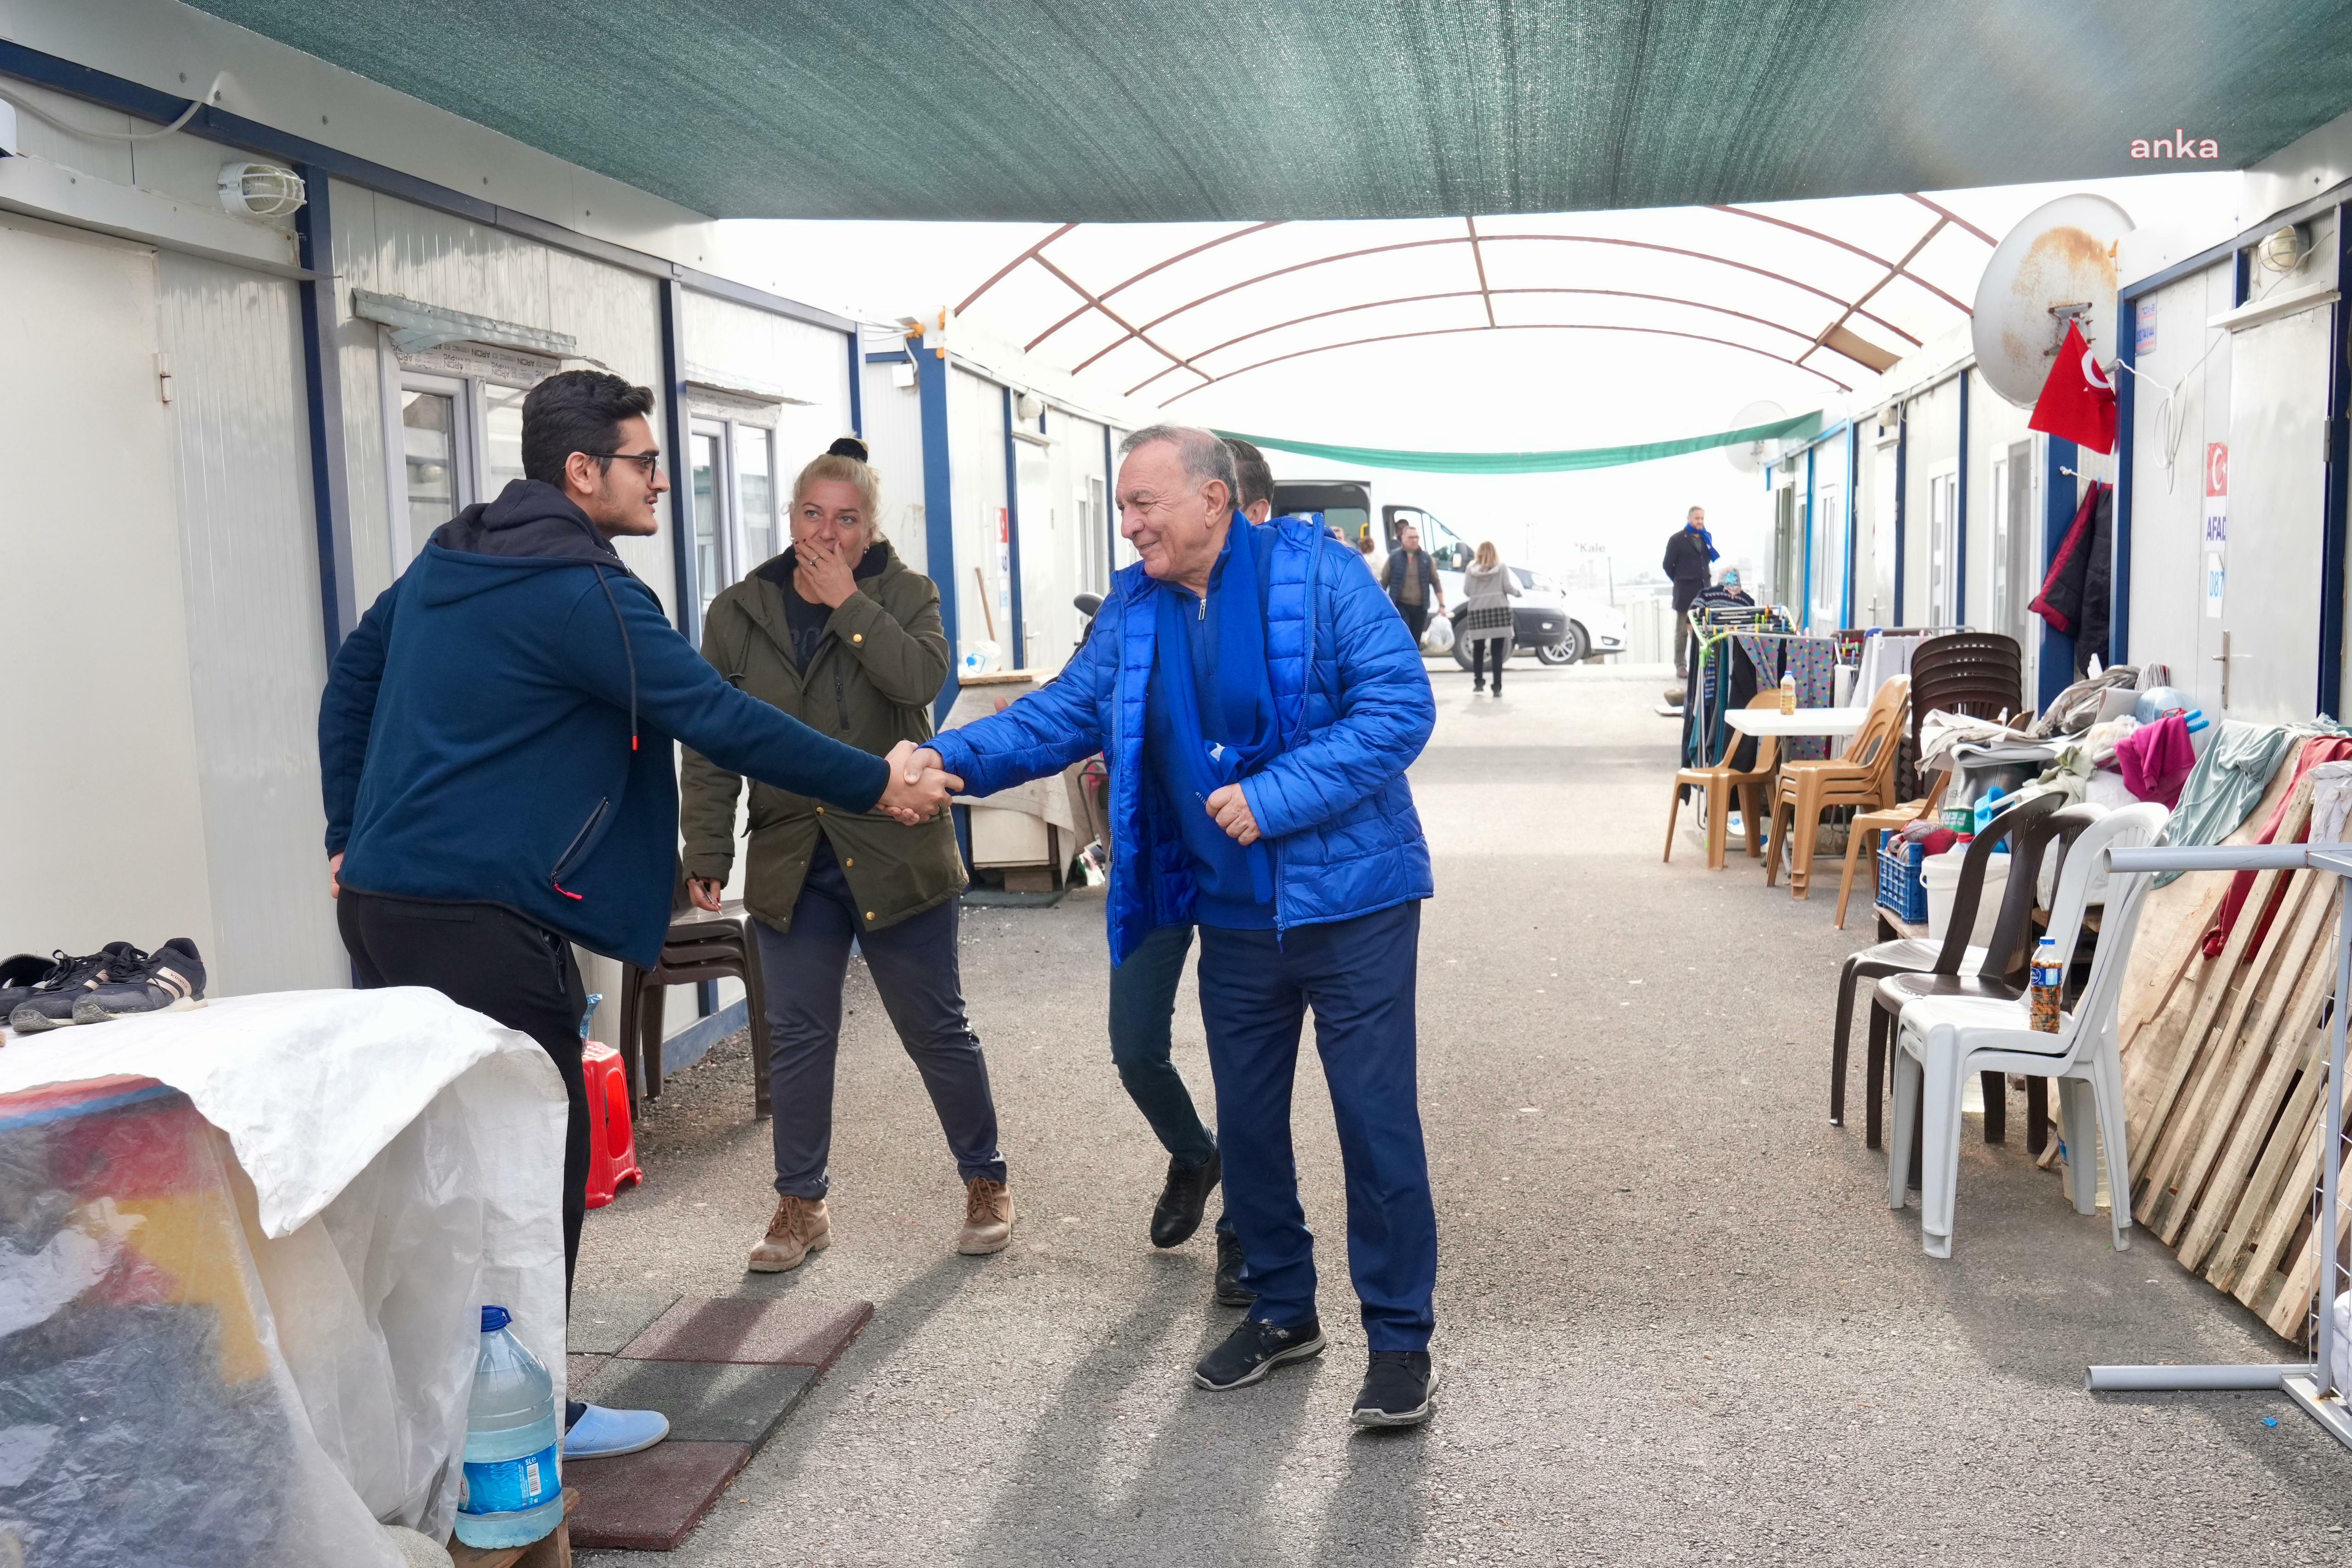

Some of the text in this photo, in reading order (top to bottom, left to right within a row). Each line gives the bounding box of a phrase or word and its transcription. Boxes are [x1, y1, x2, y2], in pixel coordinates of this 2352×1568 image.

[1580, 542, 1606, 552] Kale
[2210, 570, 2224, 597] 087
[170, 973, 188, 989] kinetix
